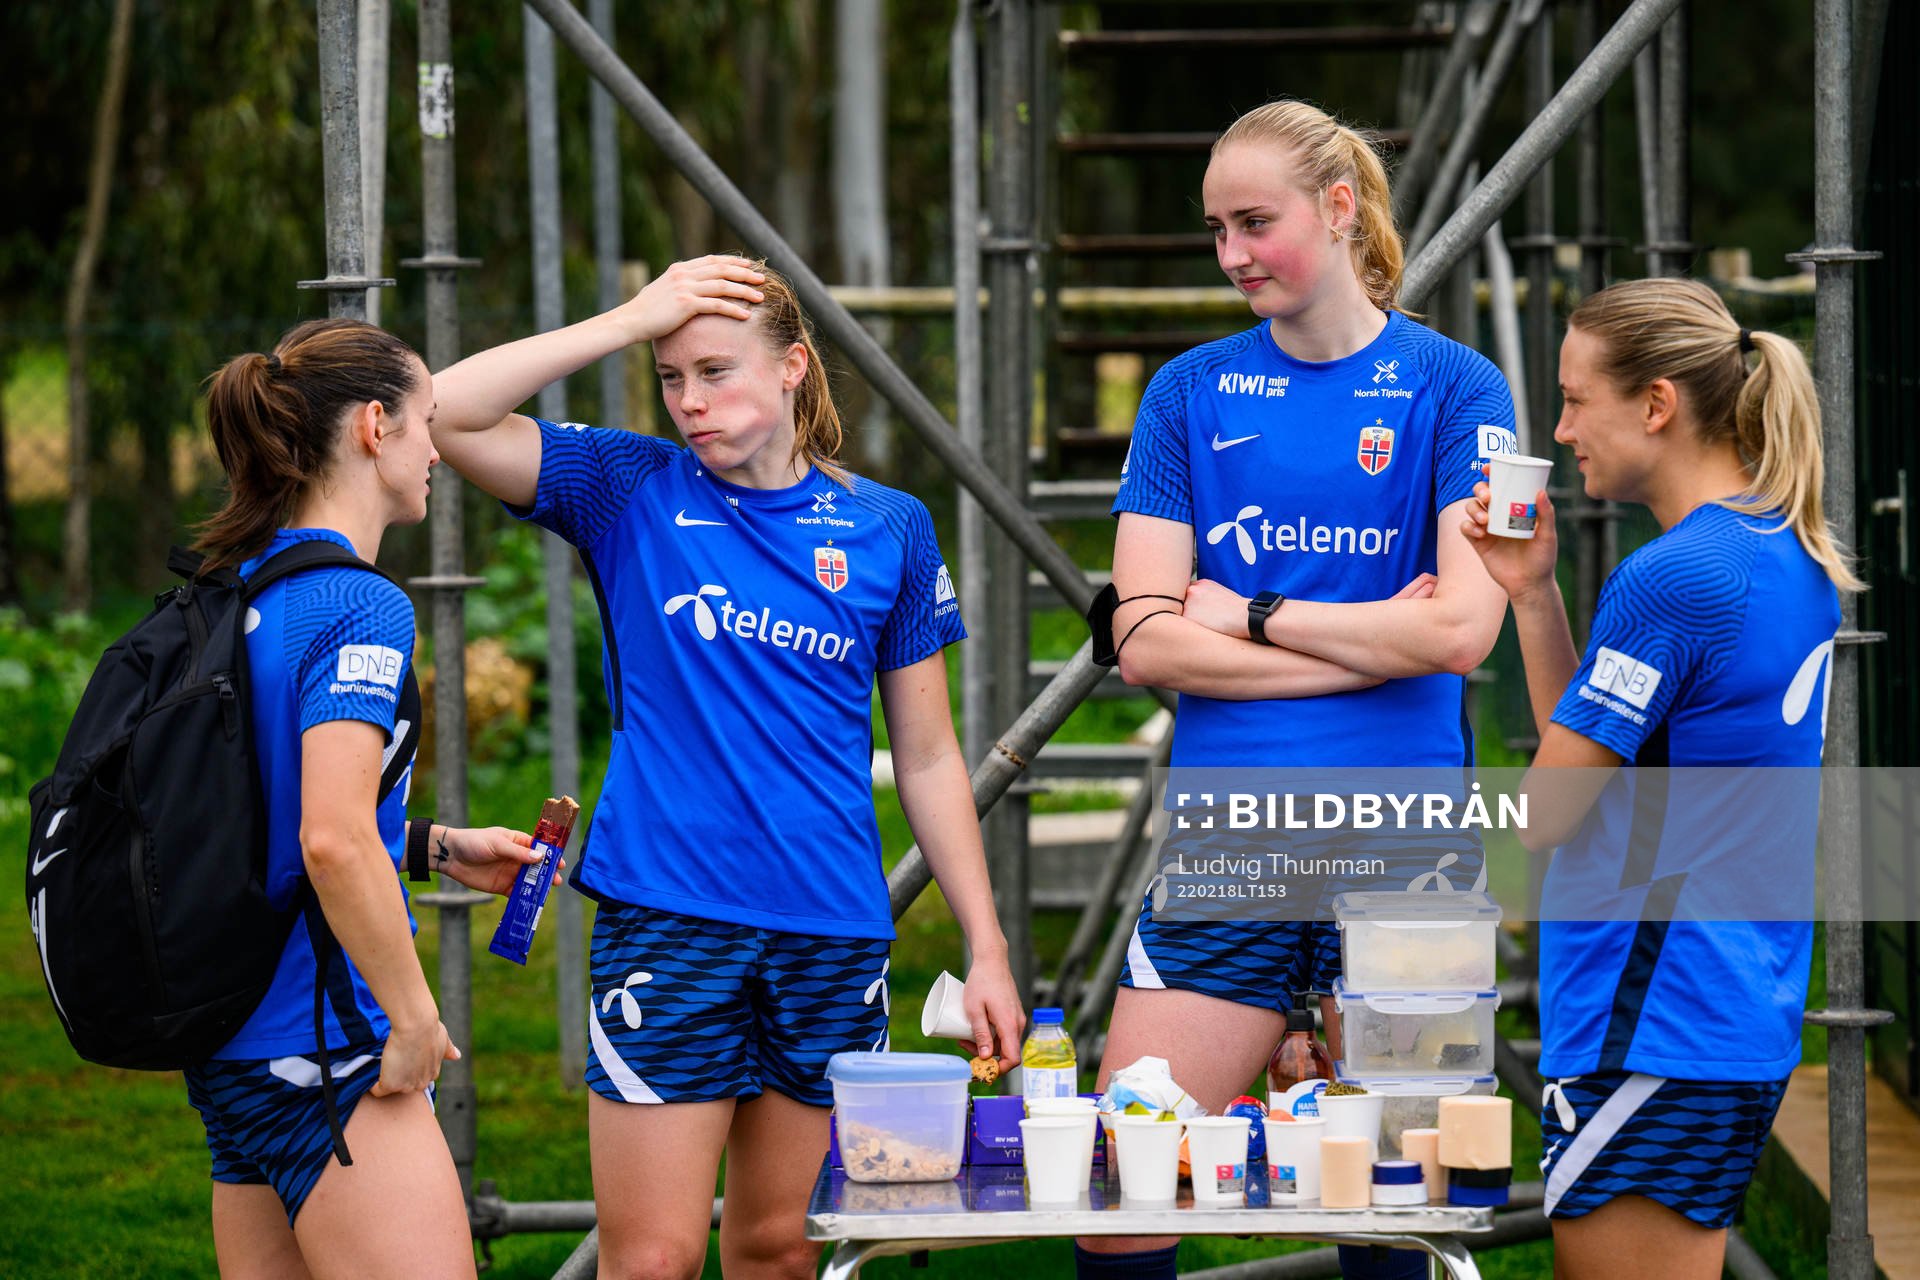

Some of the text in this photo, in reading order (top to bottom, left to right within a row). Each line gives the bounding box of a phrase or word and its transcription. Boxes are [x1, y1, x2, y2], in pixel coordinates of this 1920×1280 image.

[1218, 372, 1290, 396] KIWI mini
[1266, 386, 1286, 398] pris
[1354, 388, 1413, 399] Norsk Tipping
[796, 516, 855, 528] Norsk Tipping
[1260, 516, 1399, 556] telenor
[721, 600, 855, 663] telenor
[348, 647, 398, 680] DNB
[1599, 657, 1648, 696] DNB
[330, 682, 397, 704] #huninvestere
